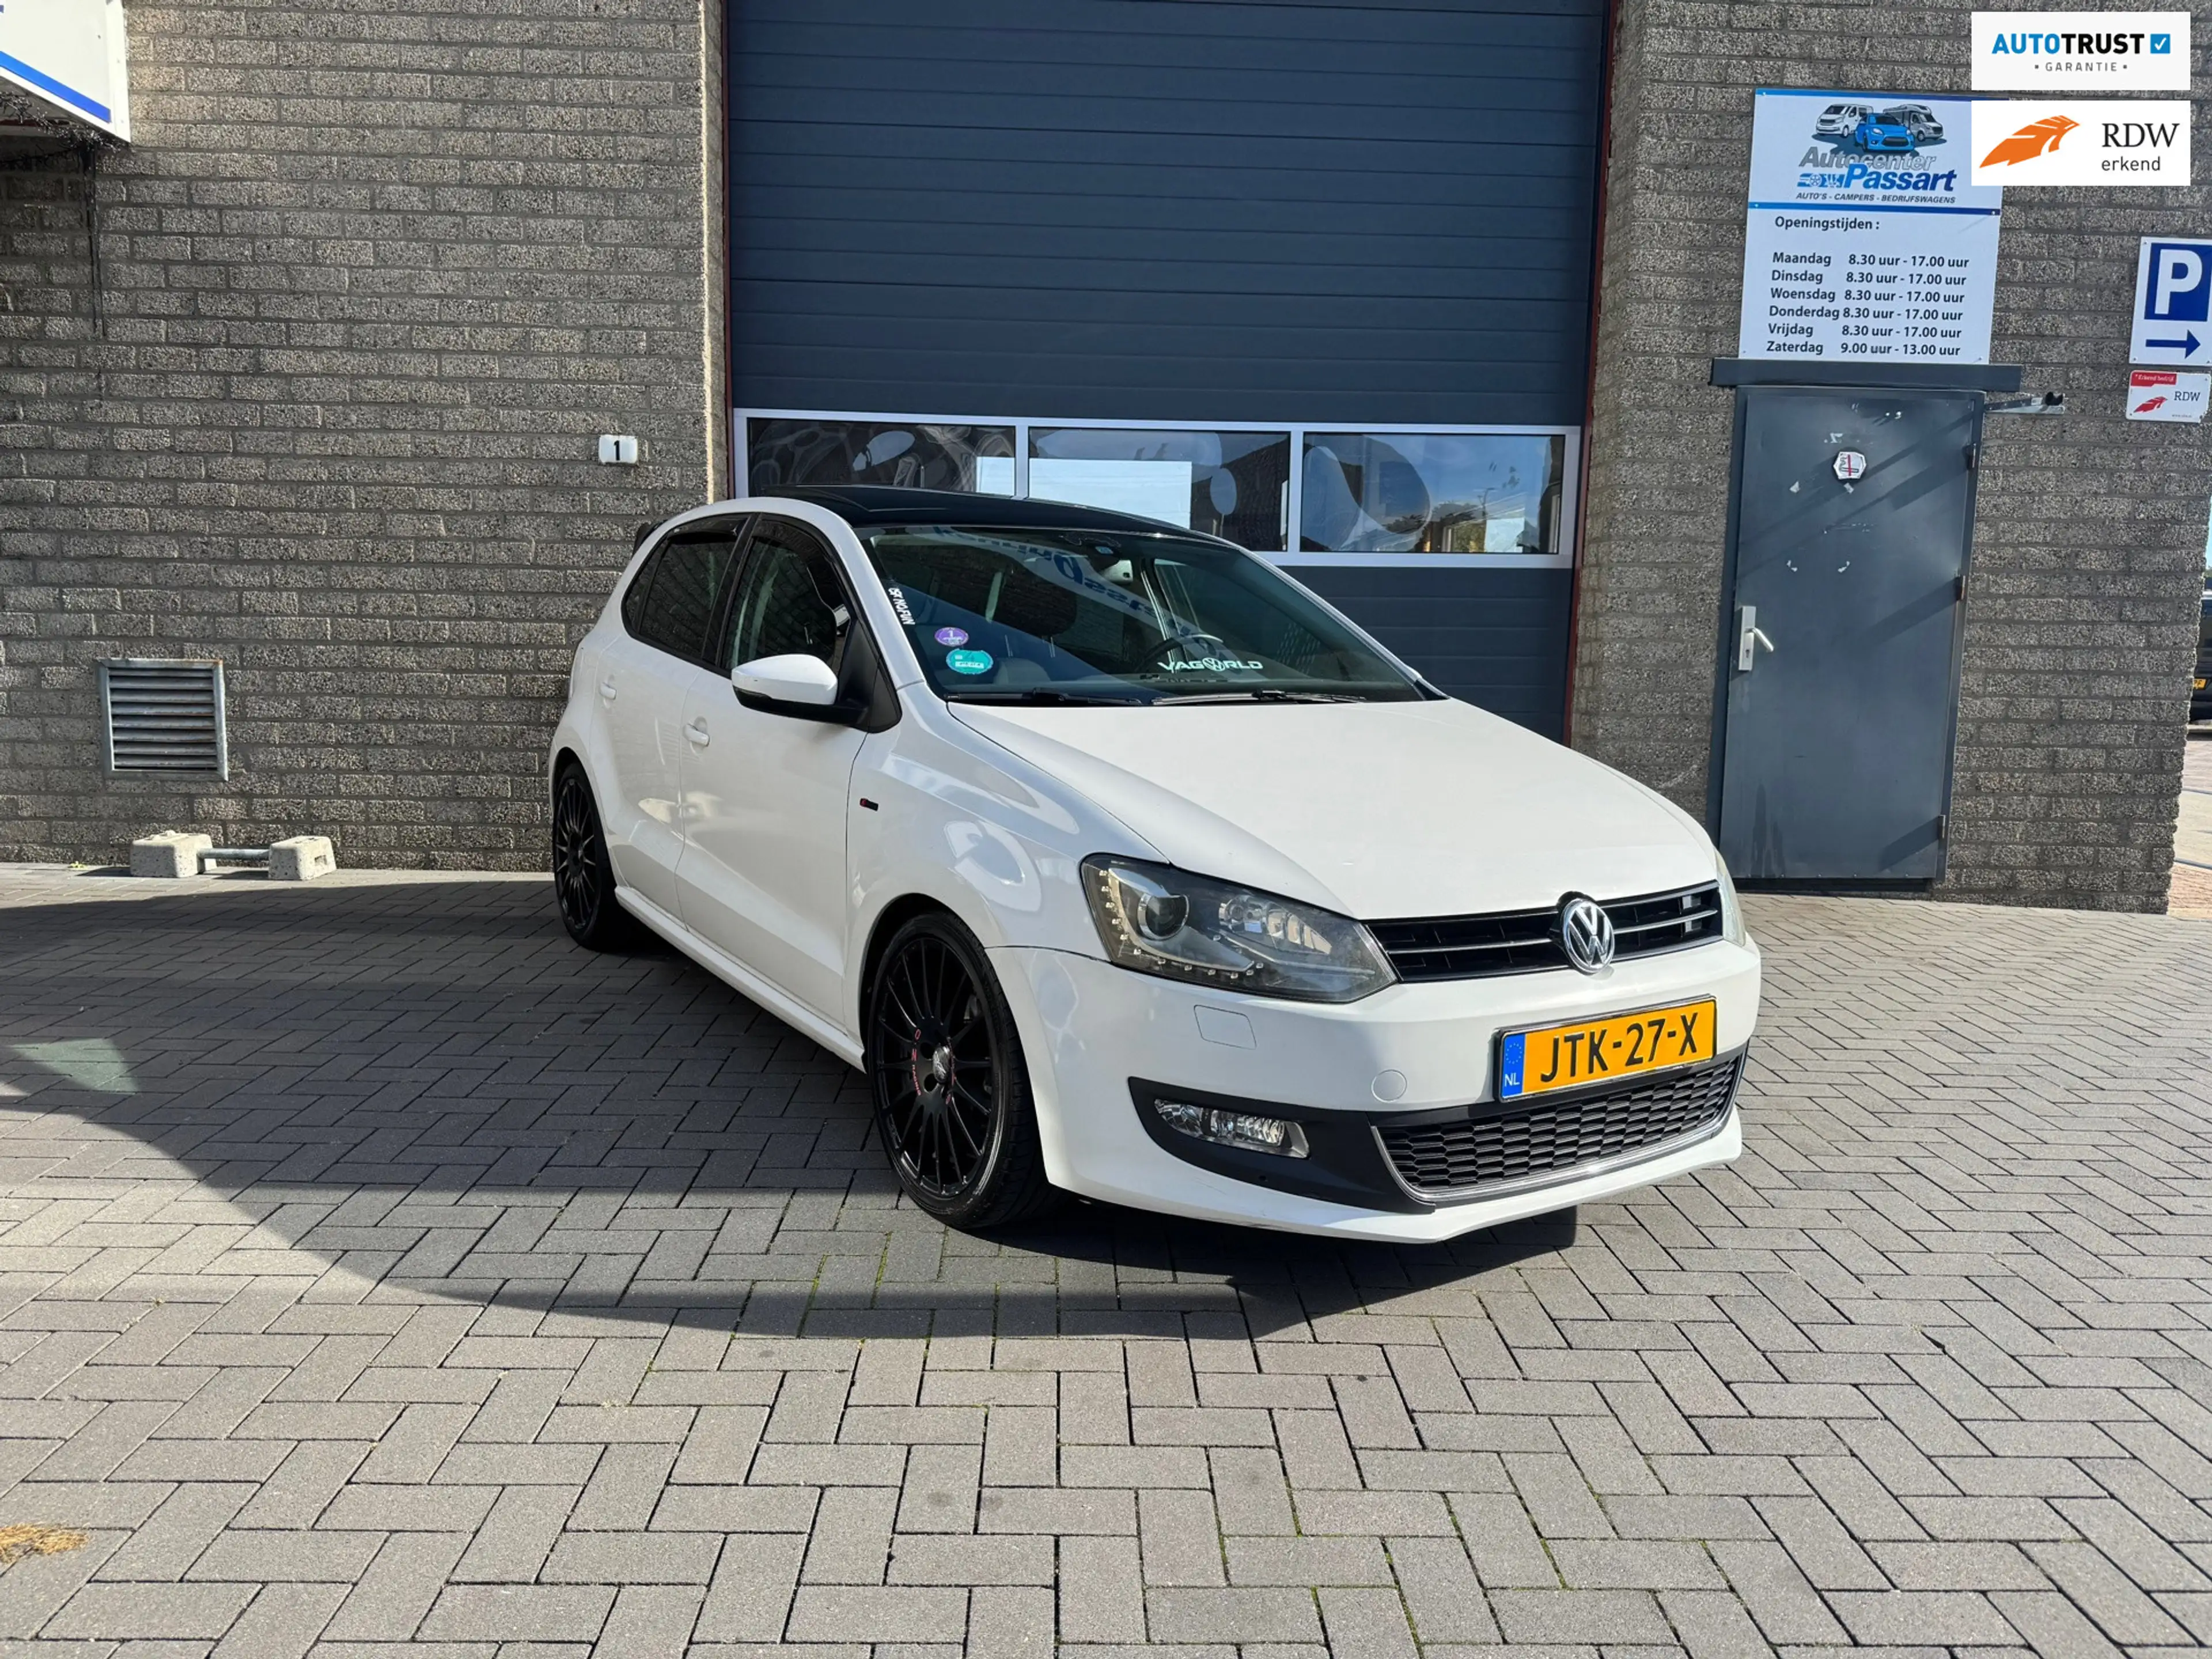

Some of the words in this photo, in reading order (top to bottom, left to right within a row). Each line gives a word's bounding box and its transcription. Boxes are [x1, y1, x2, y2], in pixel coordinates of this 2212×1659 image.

[1799, 146, 1937, 171] Autocenter
[1844, 162, 1957, 192] Passart
[1881, 195, 1956, 203] BEDRIJFSWAGENS
[1775, 215, 1873, 232] Openingstijden
[1773, 252, 1831, 267] Maandag
[1849, 254, 1875, 265] 8.30
[1879, 257, 1900, 266] uur
[1912, 256, 1944, 267] 17.00
[1948, 259, 1969, 267] uur
[1772, 270, 1823, 285] Dinsdag
[1846, 272, 1873, 283] 8.30
[1877, 275, 1897, 283] uur
[1909, 274, 1942, 285] 17.00
[1945, 277, 1966, 285] uur
[2154, 249, 2203, 315] P
[1771, 287, 1835, 302] Woensdag
[1844, 290, 1871, 300] 8.30
[1874, 293, 1896, 301] uur
[1907, 291, 1940, 302] 17.00
[1770, 305, 1839, 320] Donderdag
[1843, 308, 1869, 318] 8.30
[1873, 310, 1894, 319] uur
[1906, 309, 1938, 320] 17.00
[1942, 312, 1963, 320] uur
[1768, 323, 1813, 337] Vrijdag
[1842, 325, 1868, 336] 8.30
[1872, 328, 1893, 336] uur
[1904, 327, 1937, 337] 17.00
[1767, 341, 1823, 355] Zaterdag
[1841, 343, 1867, 353] 9.00
[1903, 344, 1936, 355] 13.00
[1940, 347, 1960, 355] uur
[2174, 391, 2200, 402] RDW
[613, 440, 621, 460] 1
[1540, 1012, 1699, 1082] JTK-27-X
[1504, 1074, 1521, 1087] NL
